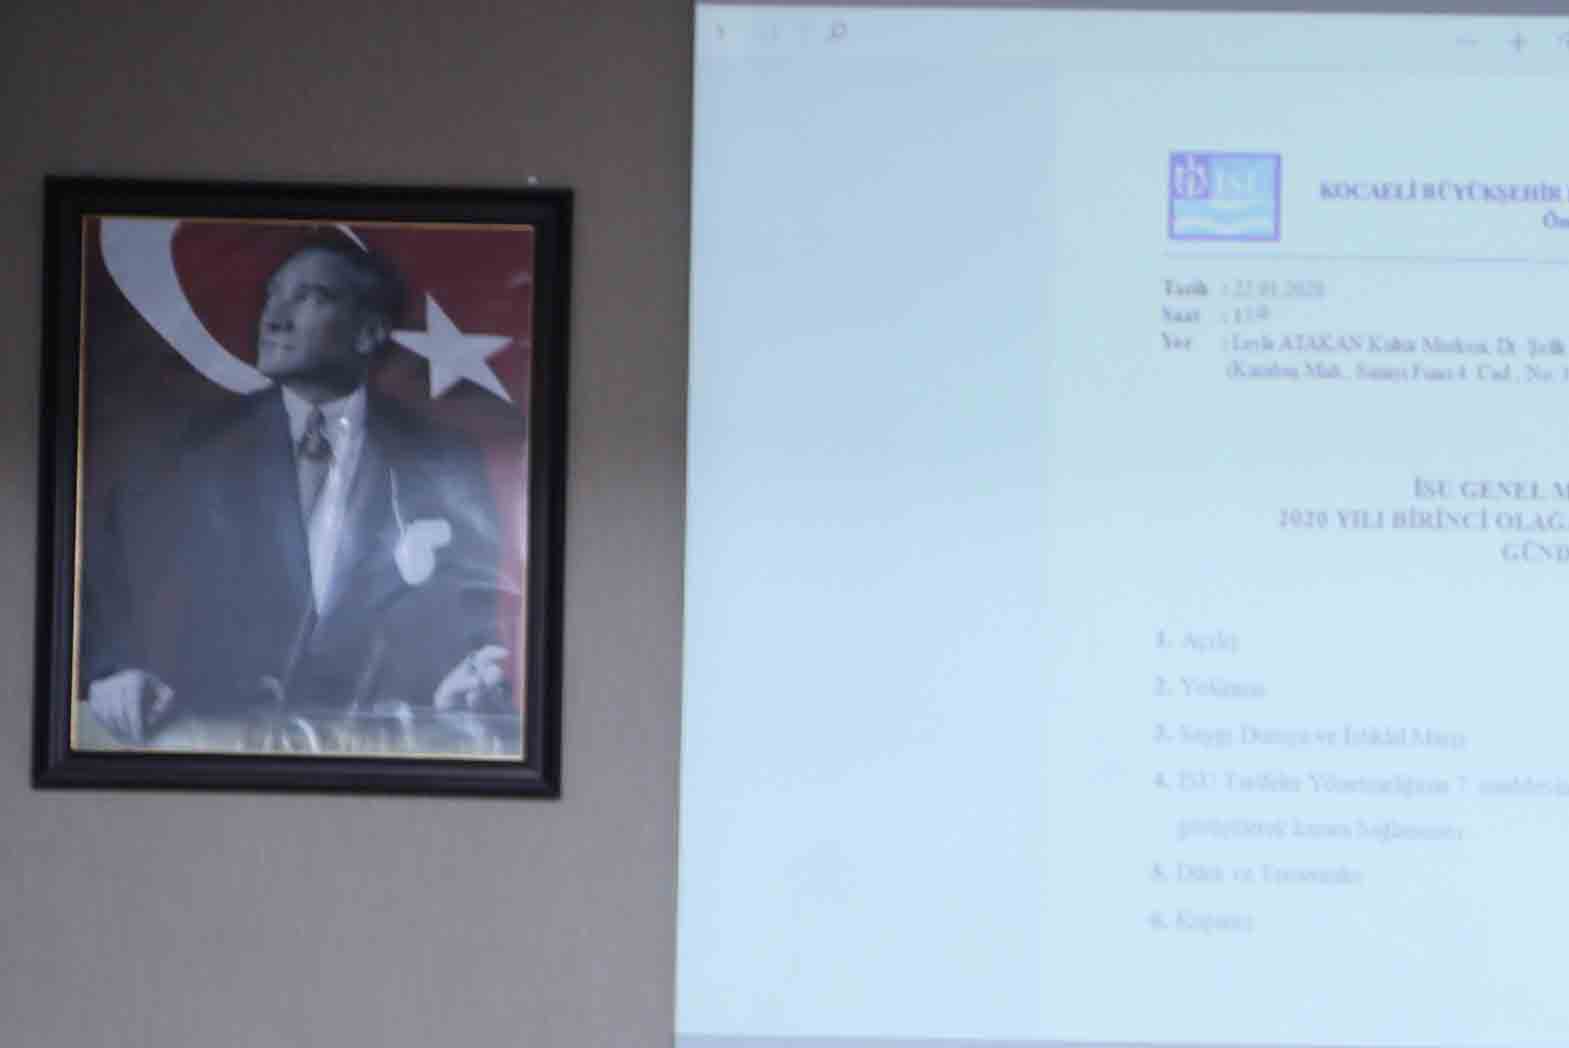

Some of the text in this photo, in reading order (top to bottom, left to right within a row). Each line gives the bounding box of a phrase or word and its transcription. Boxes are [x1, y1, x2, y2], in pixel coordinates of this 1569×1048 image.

[1319, 177, 1417, 201] KOCAELİ
[1160, 330, 1193, 352] Yer
[1278, 333, 1363, 353] ATAKAN
[1460, 479, 1546, 502] GENEL
[1280, 508, 1329, 530] 2020
[1336, 509, 1385, 530] YILI
[1391, 504, 1489, 531] BİRİNCİ
